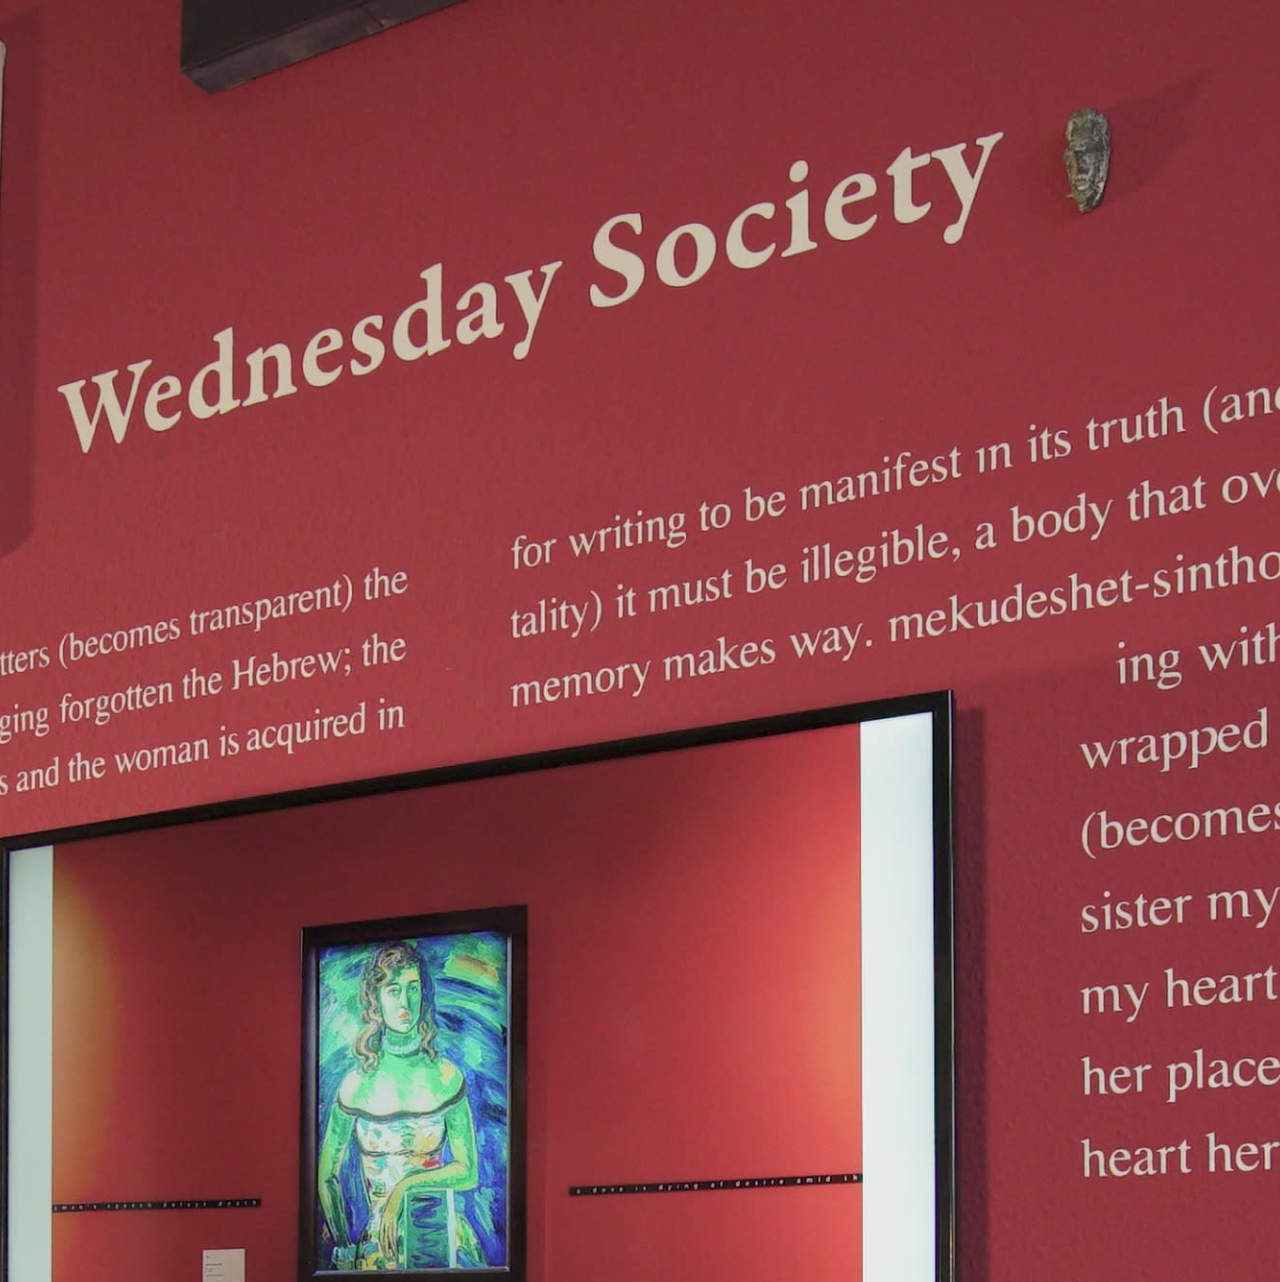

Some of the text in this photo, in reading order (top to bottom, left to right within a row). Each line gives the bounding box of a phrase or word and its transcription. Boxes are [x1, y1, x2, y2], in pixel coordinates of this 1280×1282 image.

[57, 132, 1004, 453] Wednesday Society
[511, 535, 557, 569] for
[569, 510, 687, 557] writing
[699, 501, 731, 531] to
[743, 487, 786, 521] be
[799, 446, 962, 510] manifest
[976, 443, 1013, 473] in
[1027, 424, 1071, 462] its
[1086, 397, 1186, 450] truth
[510, 590, 602, 638] tality)
[616, 584, 636, 618] it
[648, 569, 732, 612] must
[744, 559, 787, 593] be
[801, 524, 960, 583] illegible,
[975, 523, 997, 550] a
[1010, 492, 1113, 542] body
[1127, 476, 1206, 521] that
[59, 618, 180, 669] (becomes
[189, 574, 352, 635] transparent)
[364, 567, 408, 600] the
[59, 683, 173, 725] forgotten
[182, 668, 222, 699] the
[232, 648, 351, 690] Hebrew;
[362, 633, 406, 666] the
[511, 660, 651, 707] memory
[664, 636, 776, 680] makes
[790, 623, 872, 661] way.
[1116, 642, 1182, 690] ing
[16, 756, 59, 792] and
[68, 752, 106, 783] the
[114, 739, 209, 773] woman
[219, 725, 239, 756] is
[246, 702, 365, 754] acquired
[378, 698, 405, 730] in
[1080, 707, 1267, 772] wrapped
[1081, 891, 1192, 932] sister
[1207, 887, 1280, 928] my
[1080, 983, 1150, 1022] my
[1164, 965, 1278, 1007] heart
[1081, 1056, 1152, 1095] her
[1166, 1048, 1280, 1103] place
[658, 1183, 699, 1191] dying
[735, 1178, 784, 1187] desire
[1081, 1138, 1192, 1177] heart
[1205, 1132, 1280, 1172] her
